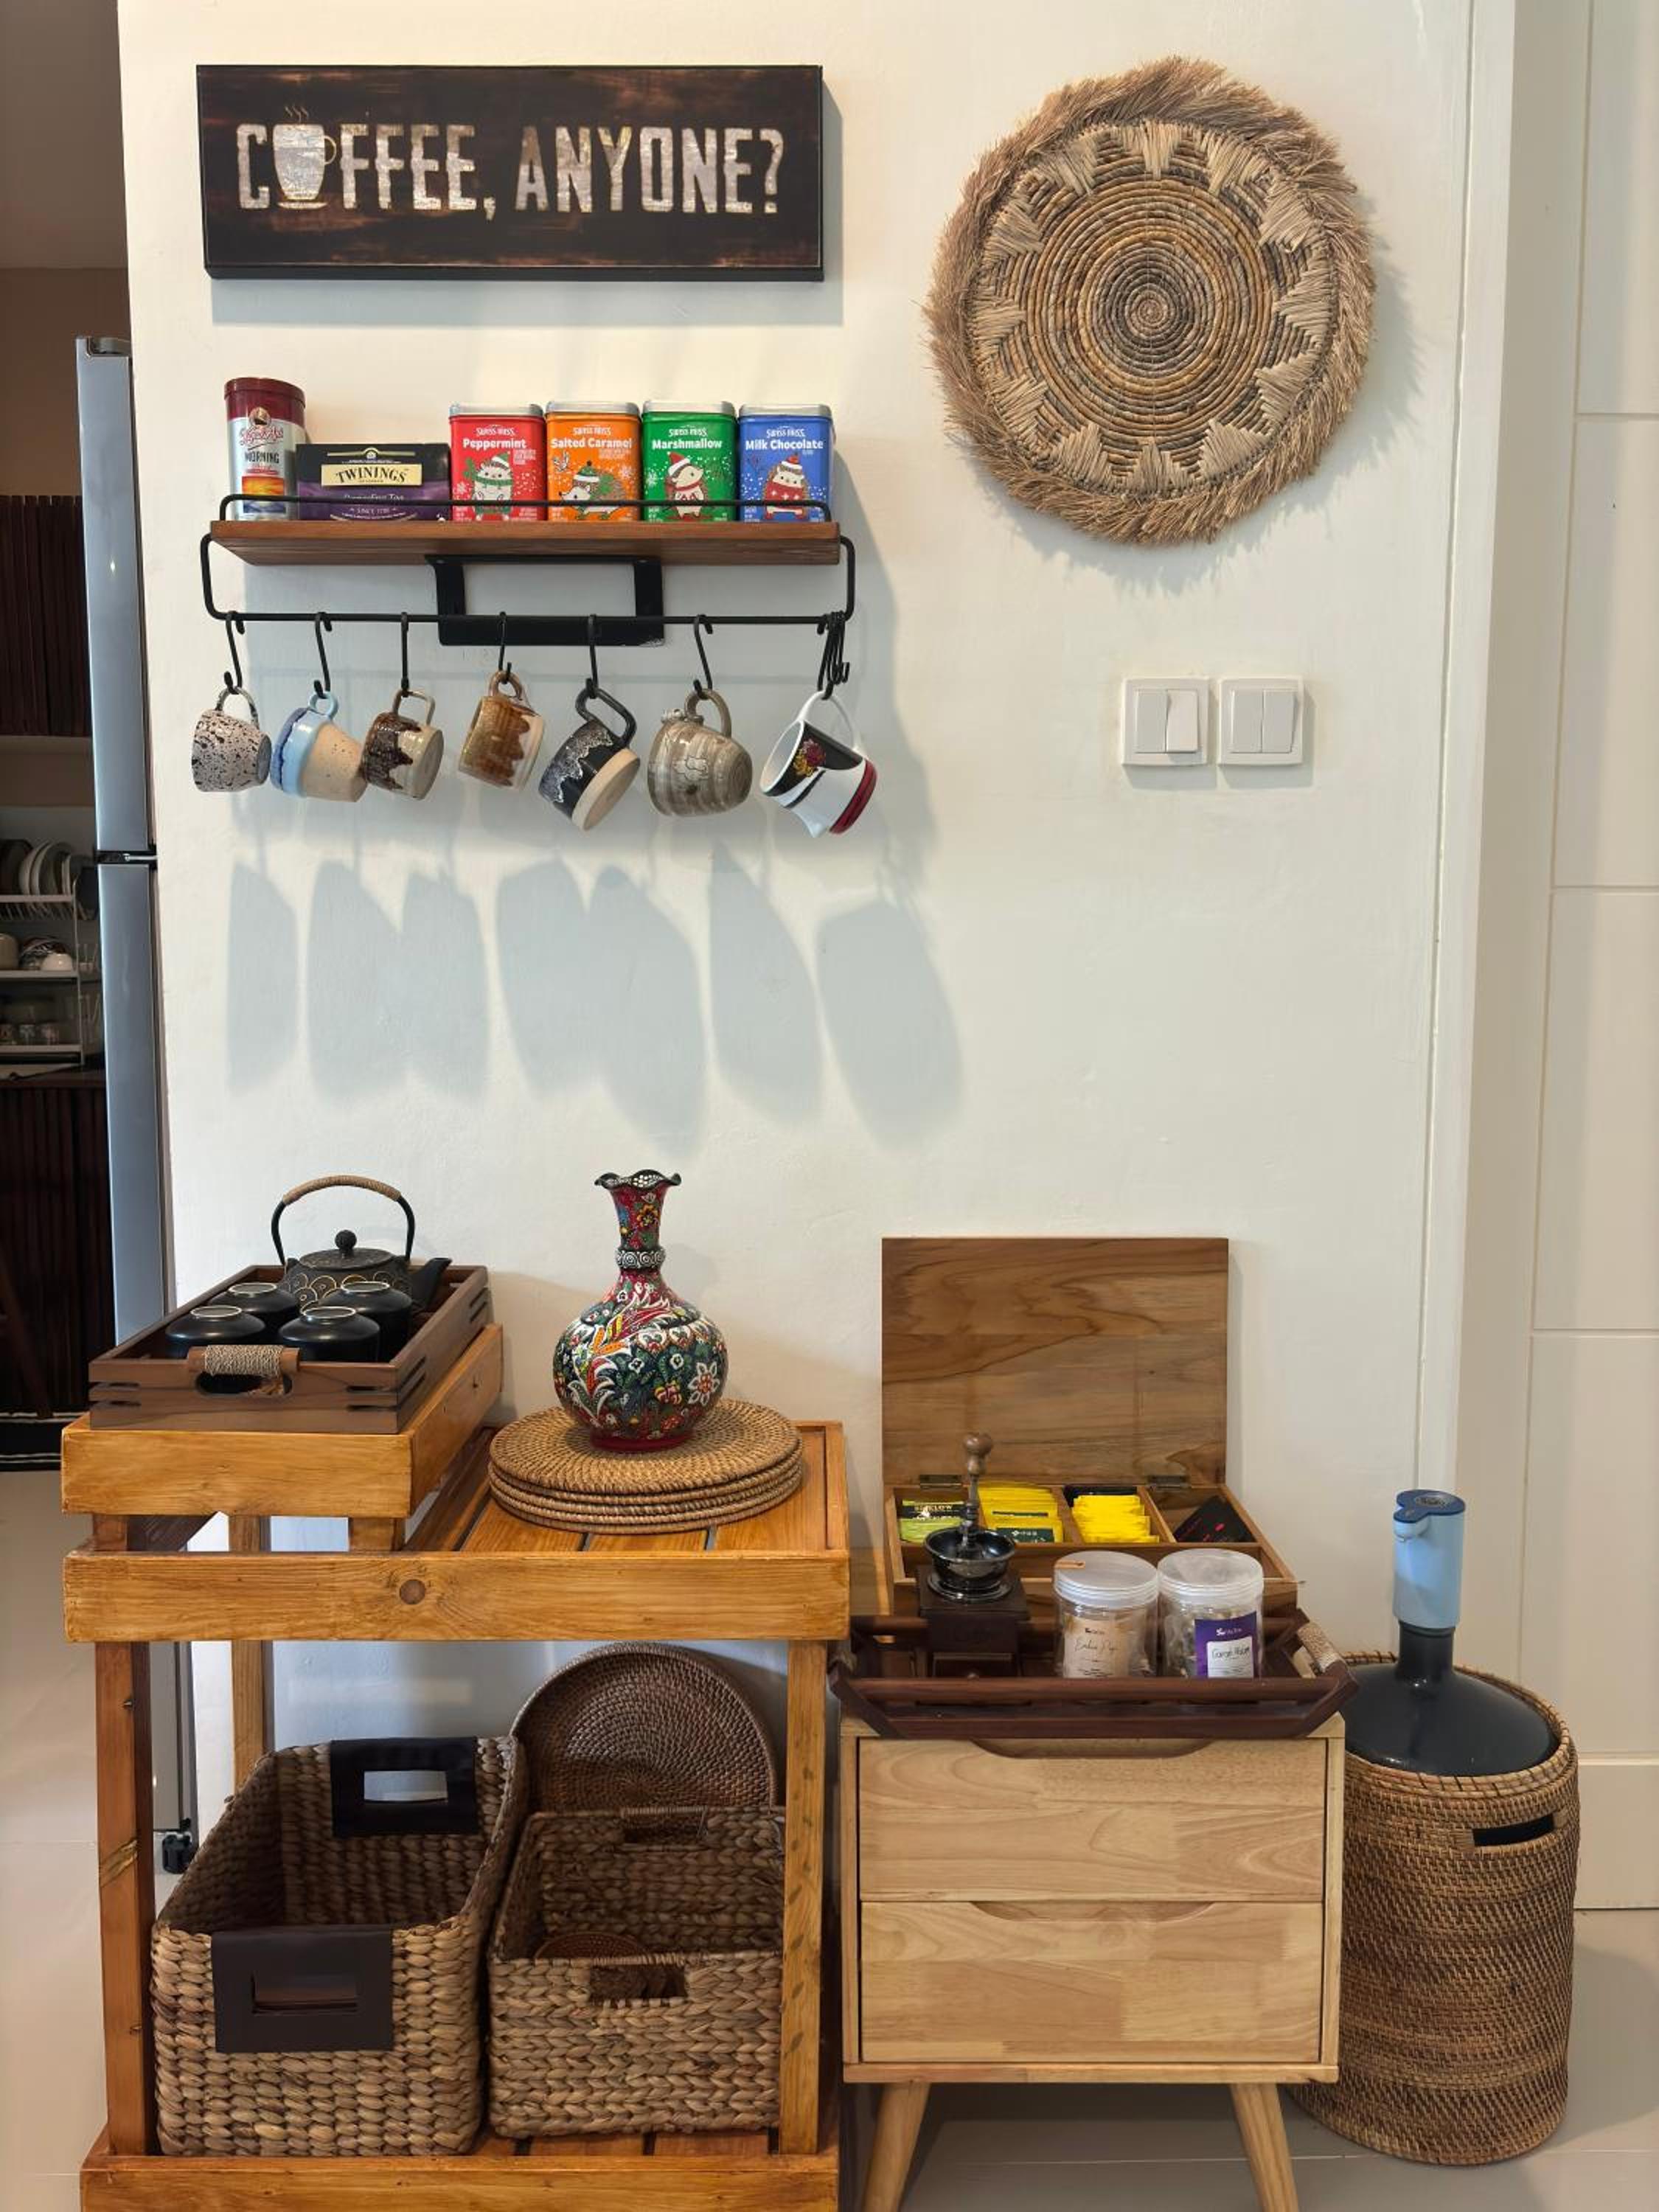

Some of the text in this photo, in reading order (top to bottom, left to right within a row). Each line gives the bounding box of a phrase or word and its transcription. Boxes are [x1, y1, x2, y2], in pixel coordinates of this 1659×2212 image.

[515, 125, 785, 214] ANYONE?
[463, 438, 526, 451] Peppermint
[551, 437, 632, 448] Salted Caramel
[652, 438, 723, 450] Marshmallow
[745, 439, 824, 450] Milk Chocolate
[245, 451, 279, 464] MORNING
[335, 466, 408, 483] TWININGS
